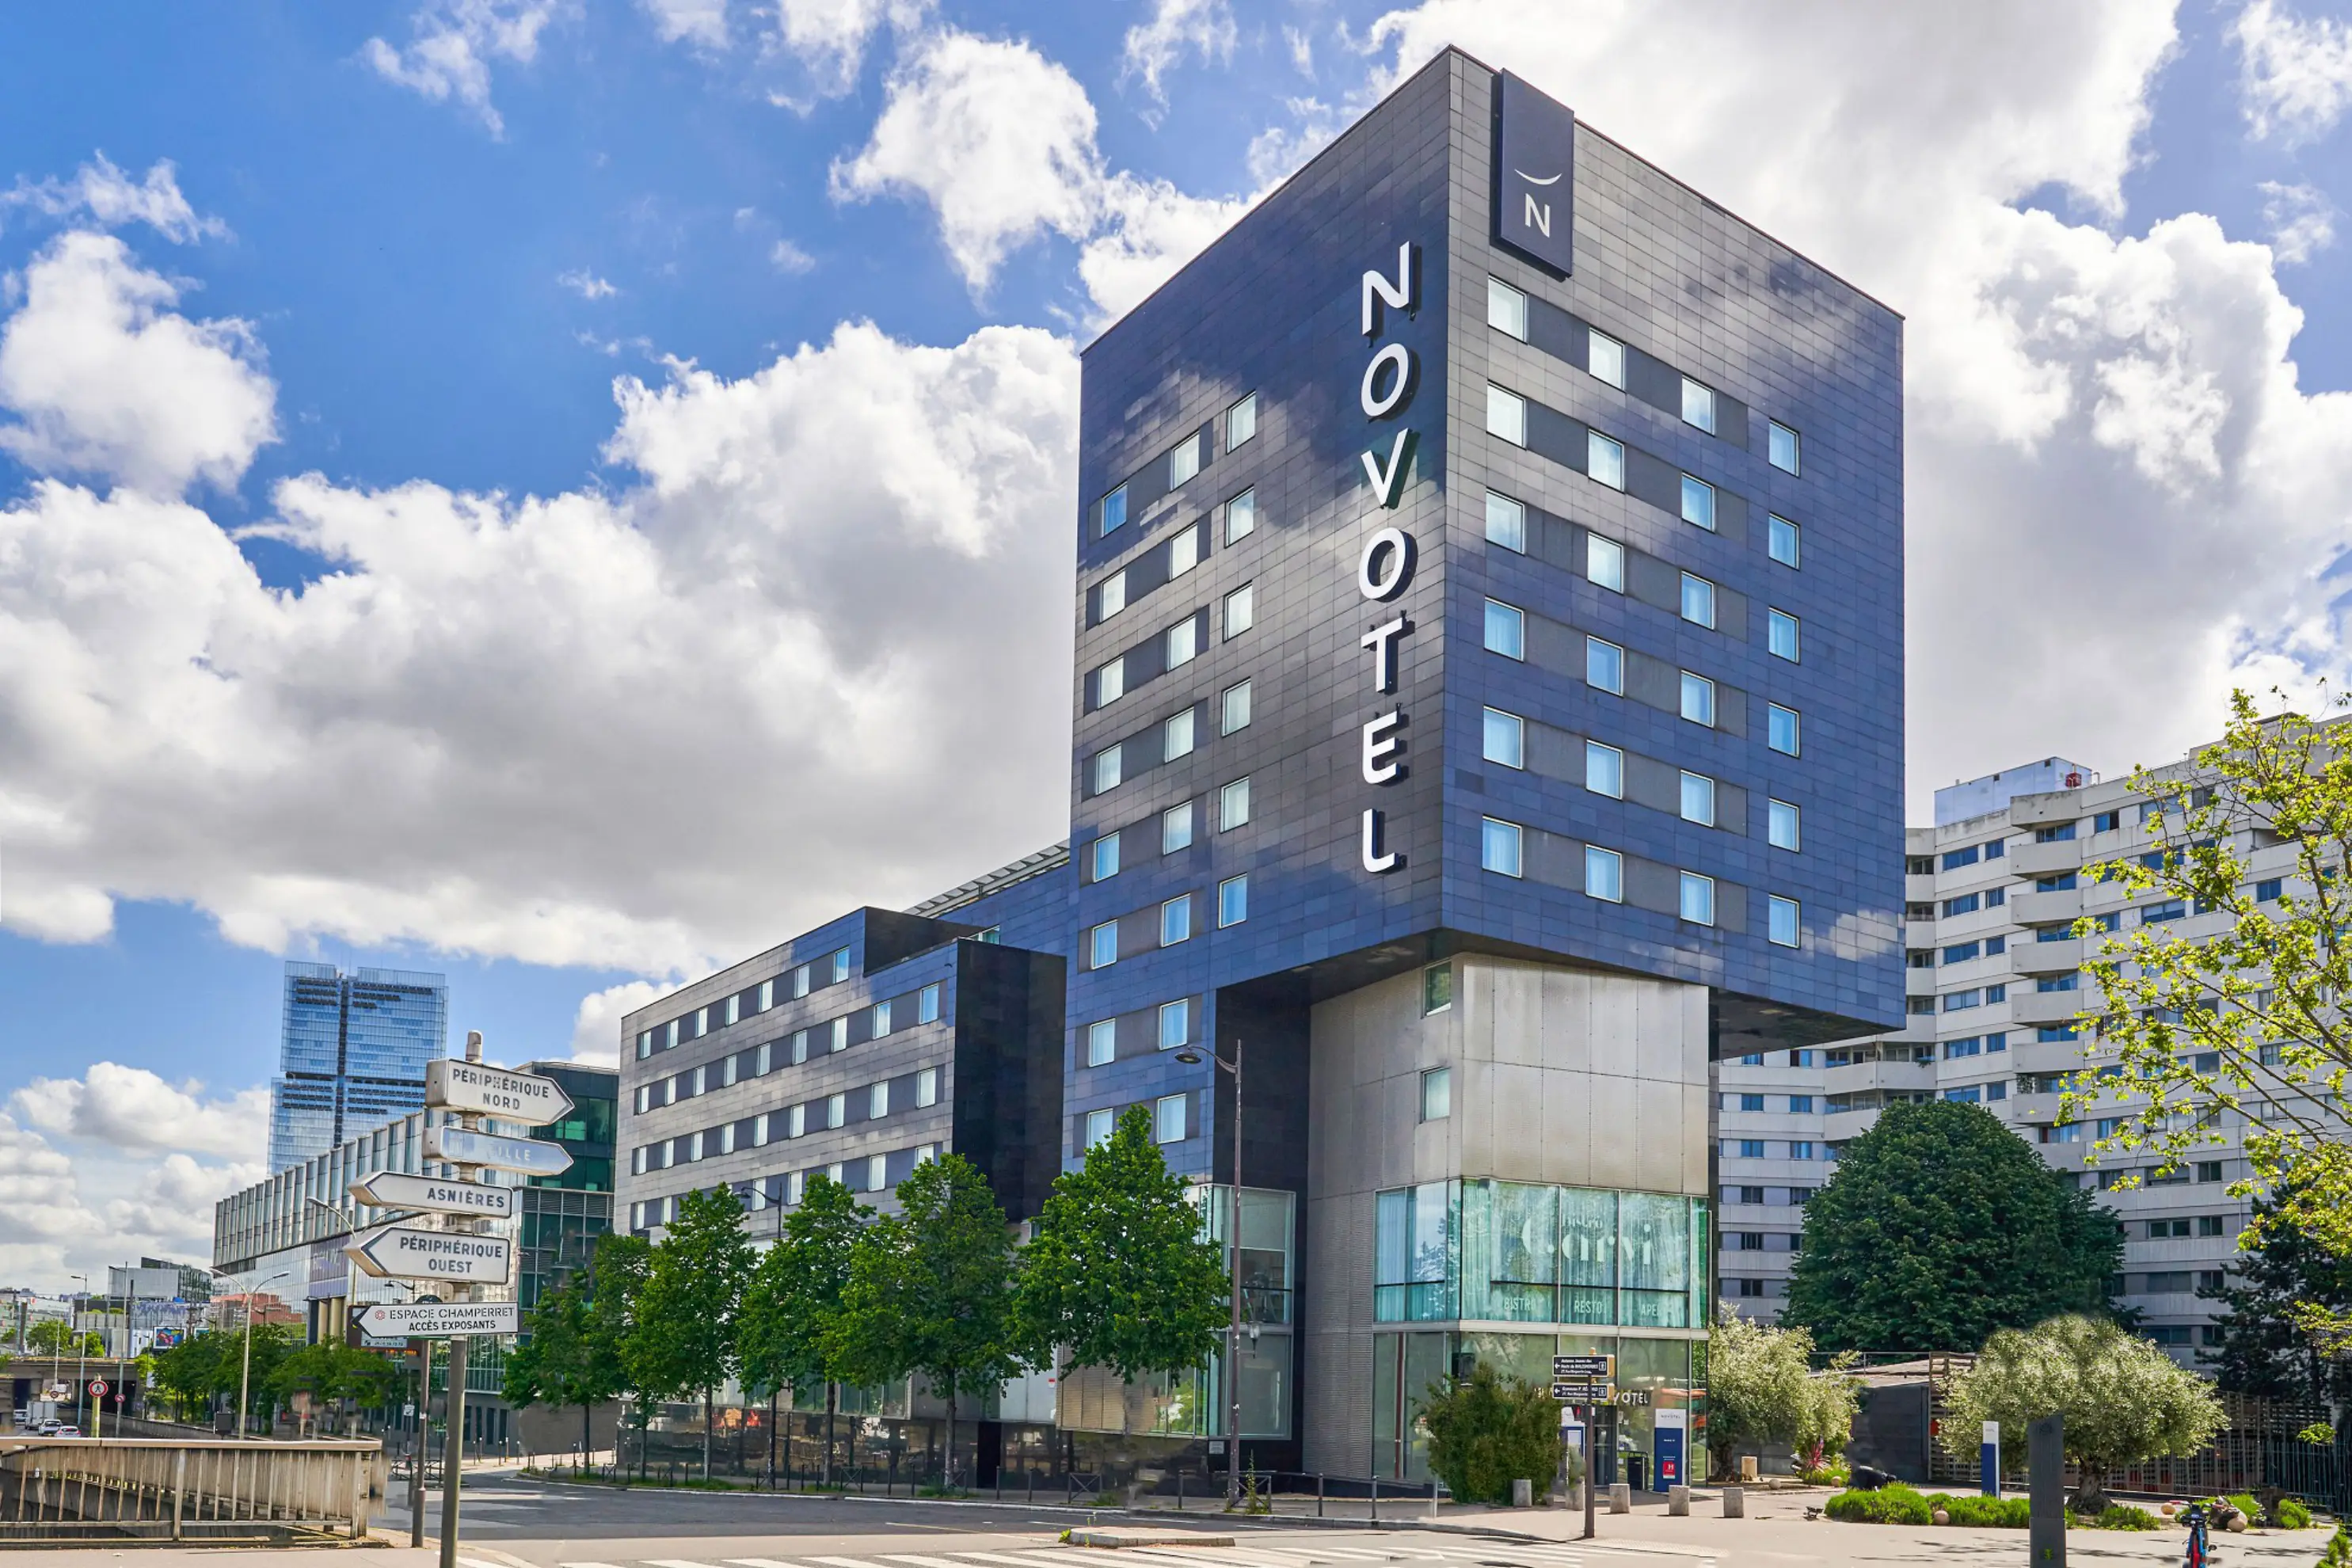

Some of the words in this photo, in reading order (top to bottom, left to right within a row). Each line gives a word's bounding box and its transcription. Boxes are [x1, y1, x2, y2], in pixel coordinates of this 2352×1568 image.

[1524, 192, 1551, 238] N
[1359, 241, 1412, 873] NOVOTEL
[452, 1068, 550, 1098] PÉRIPHÉRIQUE
[483, 1092, 521, 1110] NORD
[488, 1144, 531, 1162] ILLE
[427, 1187, 504, 1208] ASNIÈRES
[399, 1235, 503, 1258] PÉRIPHÉRIQUE
[428, 1258, 473, 1273] OUEST
[1504, 1297, 1536, 1311] BISTRO
[1574, 1300, 1603, 1315] RESTO
[389, 1308, 435, 1320] ESPACE
[439, 1307, 514, 1319] CHAMPERRET
[408, 1319, 439, 1332] ACCÈS
[441, 1319, 497, 1330] EXPOSANTS
